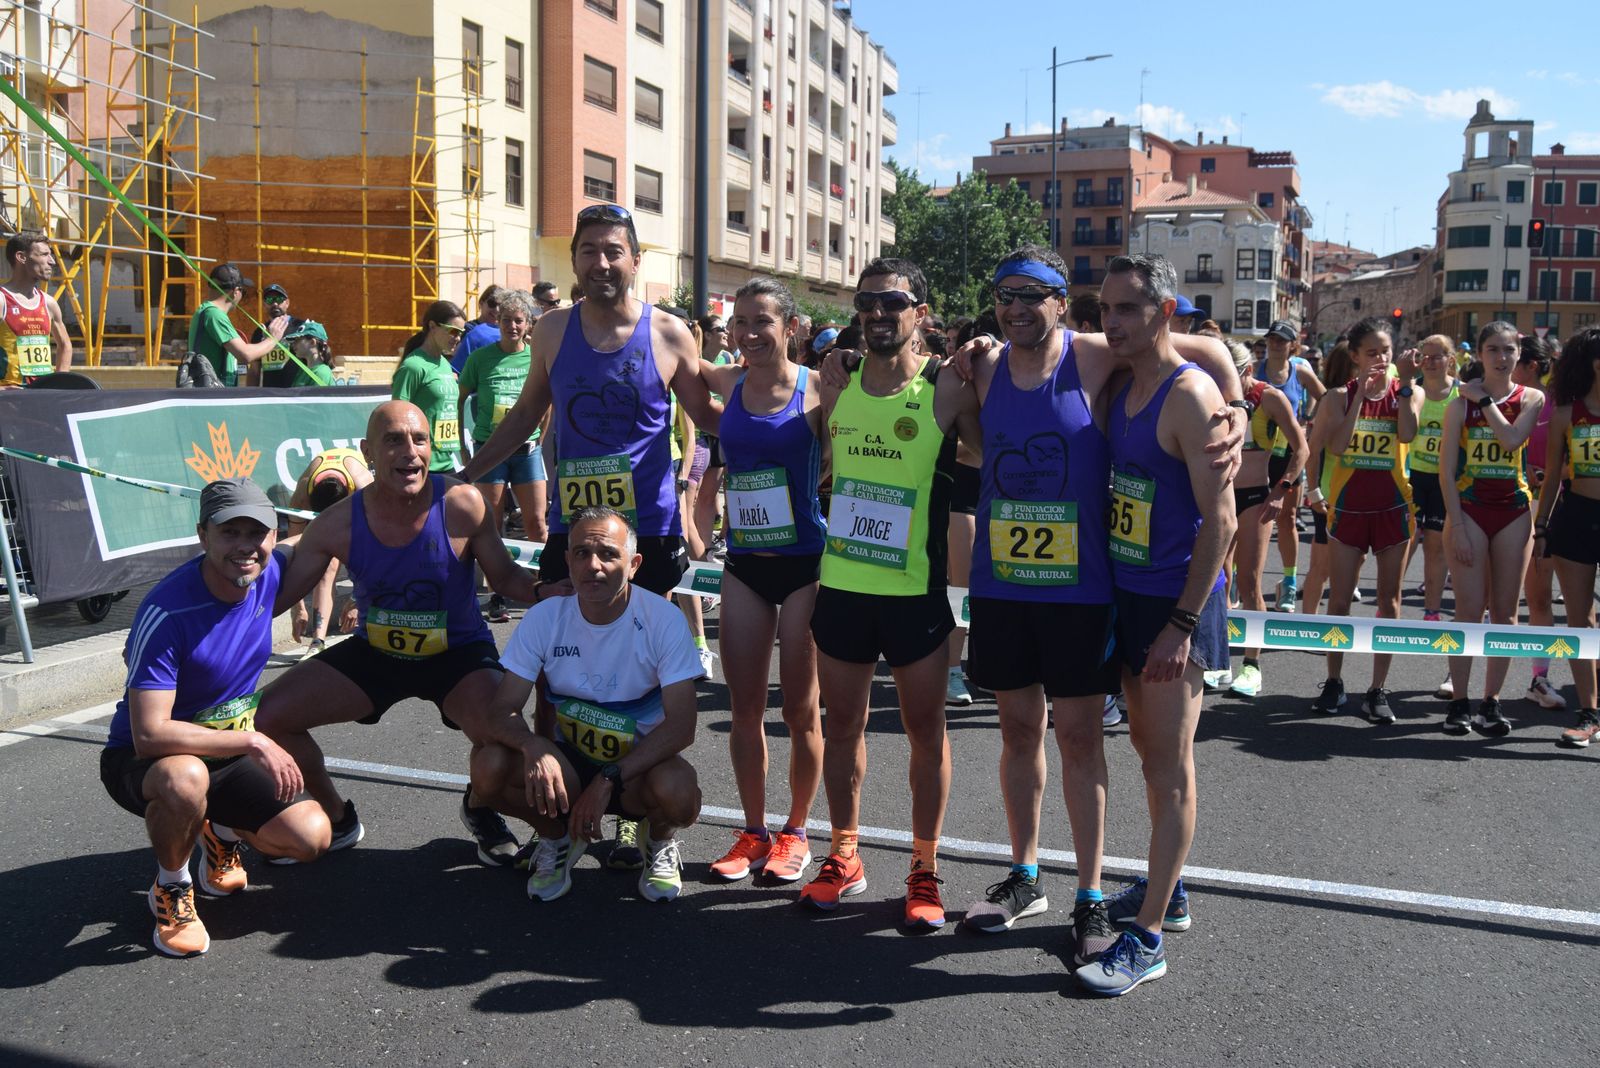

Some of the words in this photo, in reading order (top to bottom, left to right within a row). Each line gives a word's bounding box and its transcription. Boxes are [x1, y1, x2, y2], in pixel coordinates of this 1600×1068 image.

[24, 347, 49, 363] 182
[265, 350, 286, 362] 198
[439, 422, 457, 439] 184
[865, 434, 885, 445] C.A.
[1348, 433, 1391, 455] 402
[848, 446, 860, 456] LA
[862, 446, 902, 460] BAÑEZA
[1472, 442, 1514, 463] 404
[576, 458, 620, 469] FUNDACION
[576, 467, 594, 476] CAJA
[594, 465, 621, 474] RURAL
[751, 479, 777, 489] RURAL
[857, 483, 905, 499] FUNDACION
[567, 478, 625, 511] 205
[856, 491, 874, 501] CAJA
[875, 494, 903, 506] RURAL
[739, 504, 770, 526] MARÍA
[1015, 505, 1065, 514] FUNDACION
[1015, 513, 1034, 521] CAJA
[1036, 513, 1065, 521] RURAL
[850, 516, 892, 541] JORGE
[745, 533, 762, 542] CAJA
[763, 531, 792, 541] RURAL
[1010, 526, 1054, 559] 22
[847, 545, 868, 558] CAJA
[871, 549, 902, 563] RURAL
[1109, 542, 1119, 553] AJA
[1120, 546, 1145, 560] RURAL
[697, 576, 720, 585] RURAL
[1014, 569, 1037, 579] CAJA
[1039, 570, 1073, 579] RURAL
[1267, 628, 1296, 638] RURAL
[1299, 630, 1320, 639] CAJA
[1376, 634, 1404, 644] RURAL
[387, 629, 427, 653] 67
[1406, 636, 1430, 645] CAJA
[1488, 641, 1519, 650] RURAL
[1521, 642, 1544, 651] CAJA
[553, 646, 580, 658] BBVA
[578, 672, 619, 692] 224
[579, 713, 596, 725] CAJA
[598, 719, 624, 731] RURAL
[581, 706, 626, 725] FUNDACION
[566, 721, 619, 758] 149
